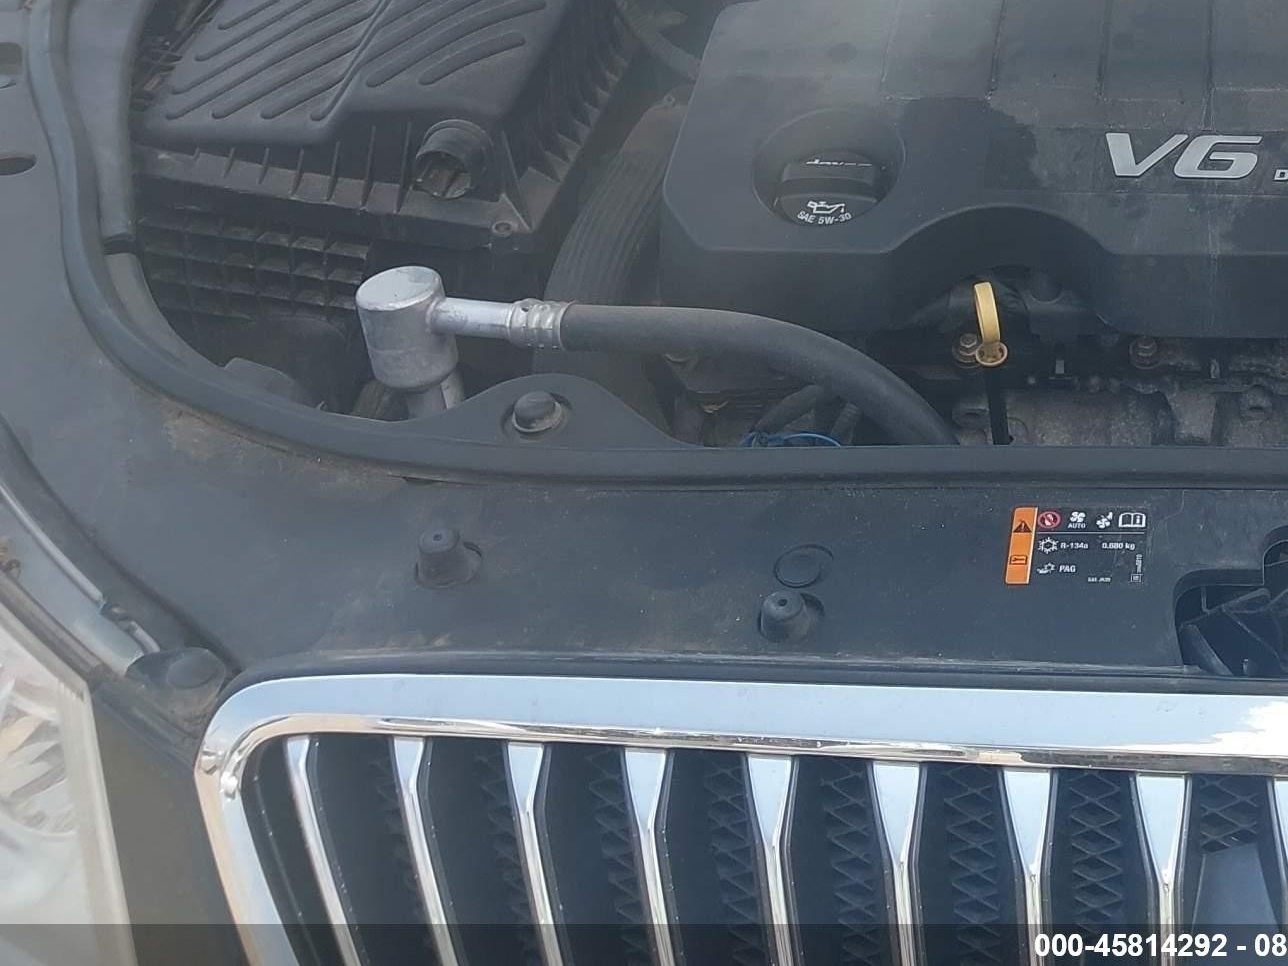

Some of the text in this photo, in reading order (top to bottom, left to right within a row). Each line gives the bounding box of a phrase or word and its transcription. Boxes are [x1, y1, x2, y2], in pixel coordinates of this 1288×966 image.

[1104, 132, 1263, 179] V6
[797, 211, 852, 225] SAE 5W-30
[1125, 543, 1136, 551] kg
[1059, 565, 1076, 573] PAG
